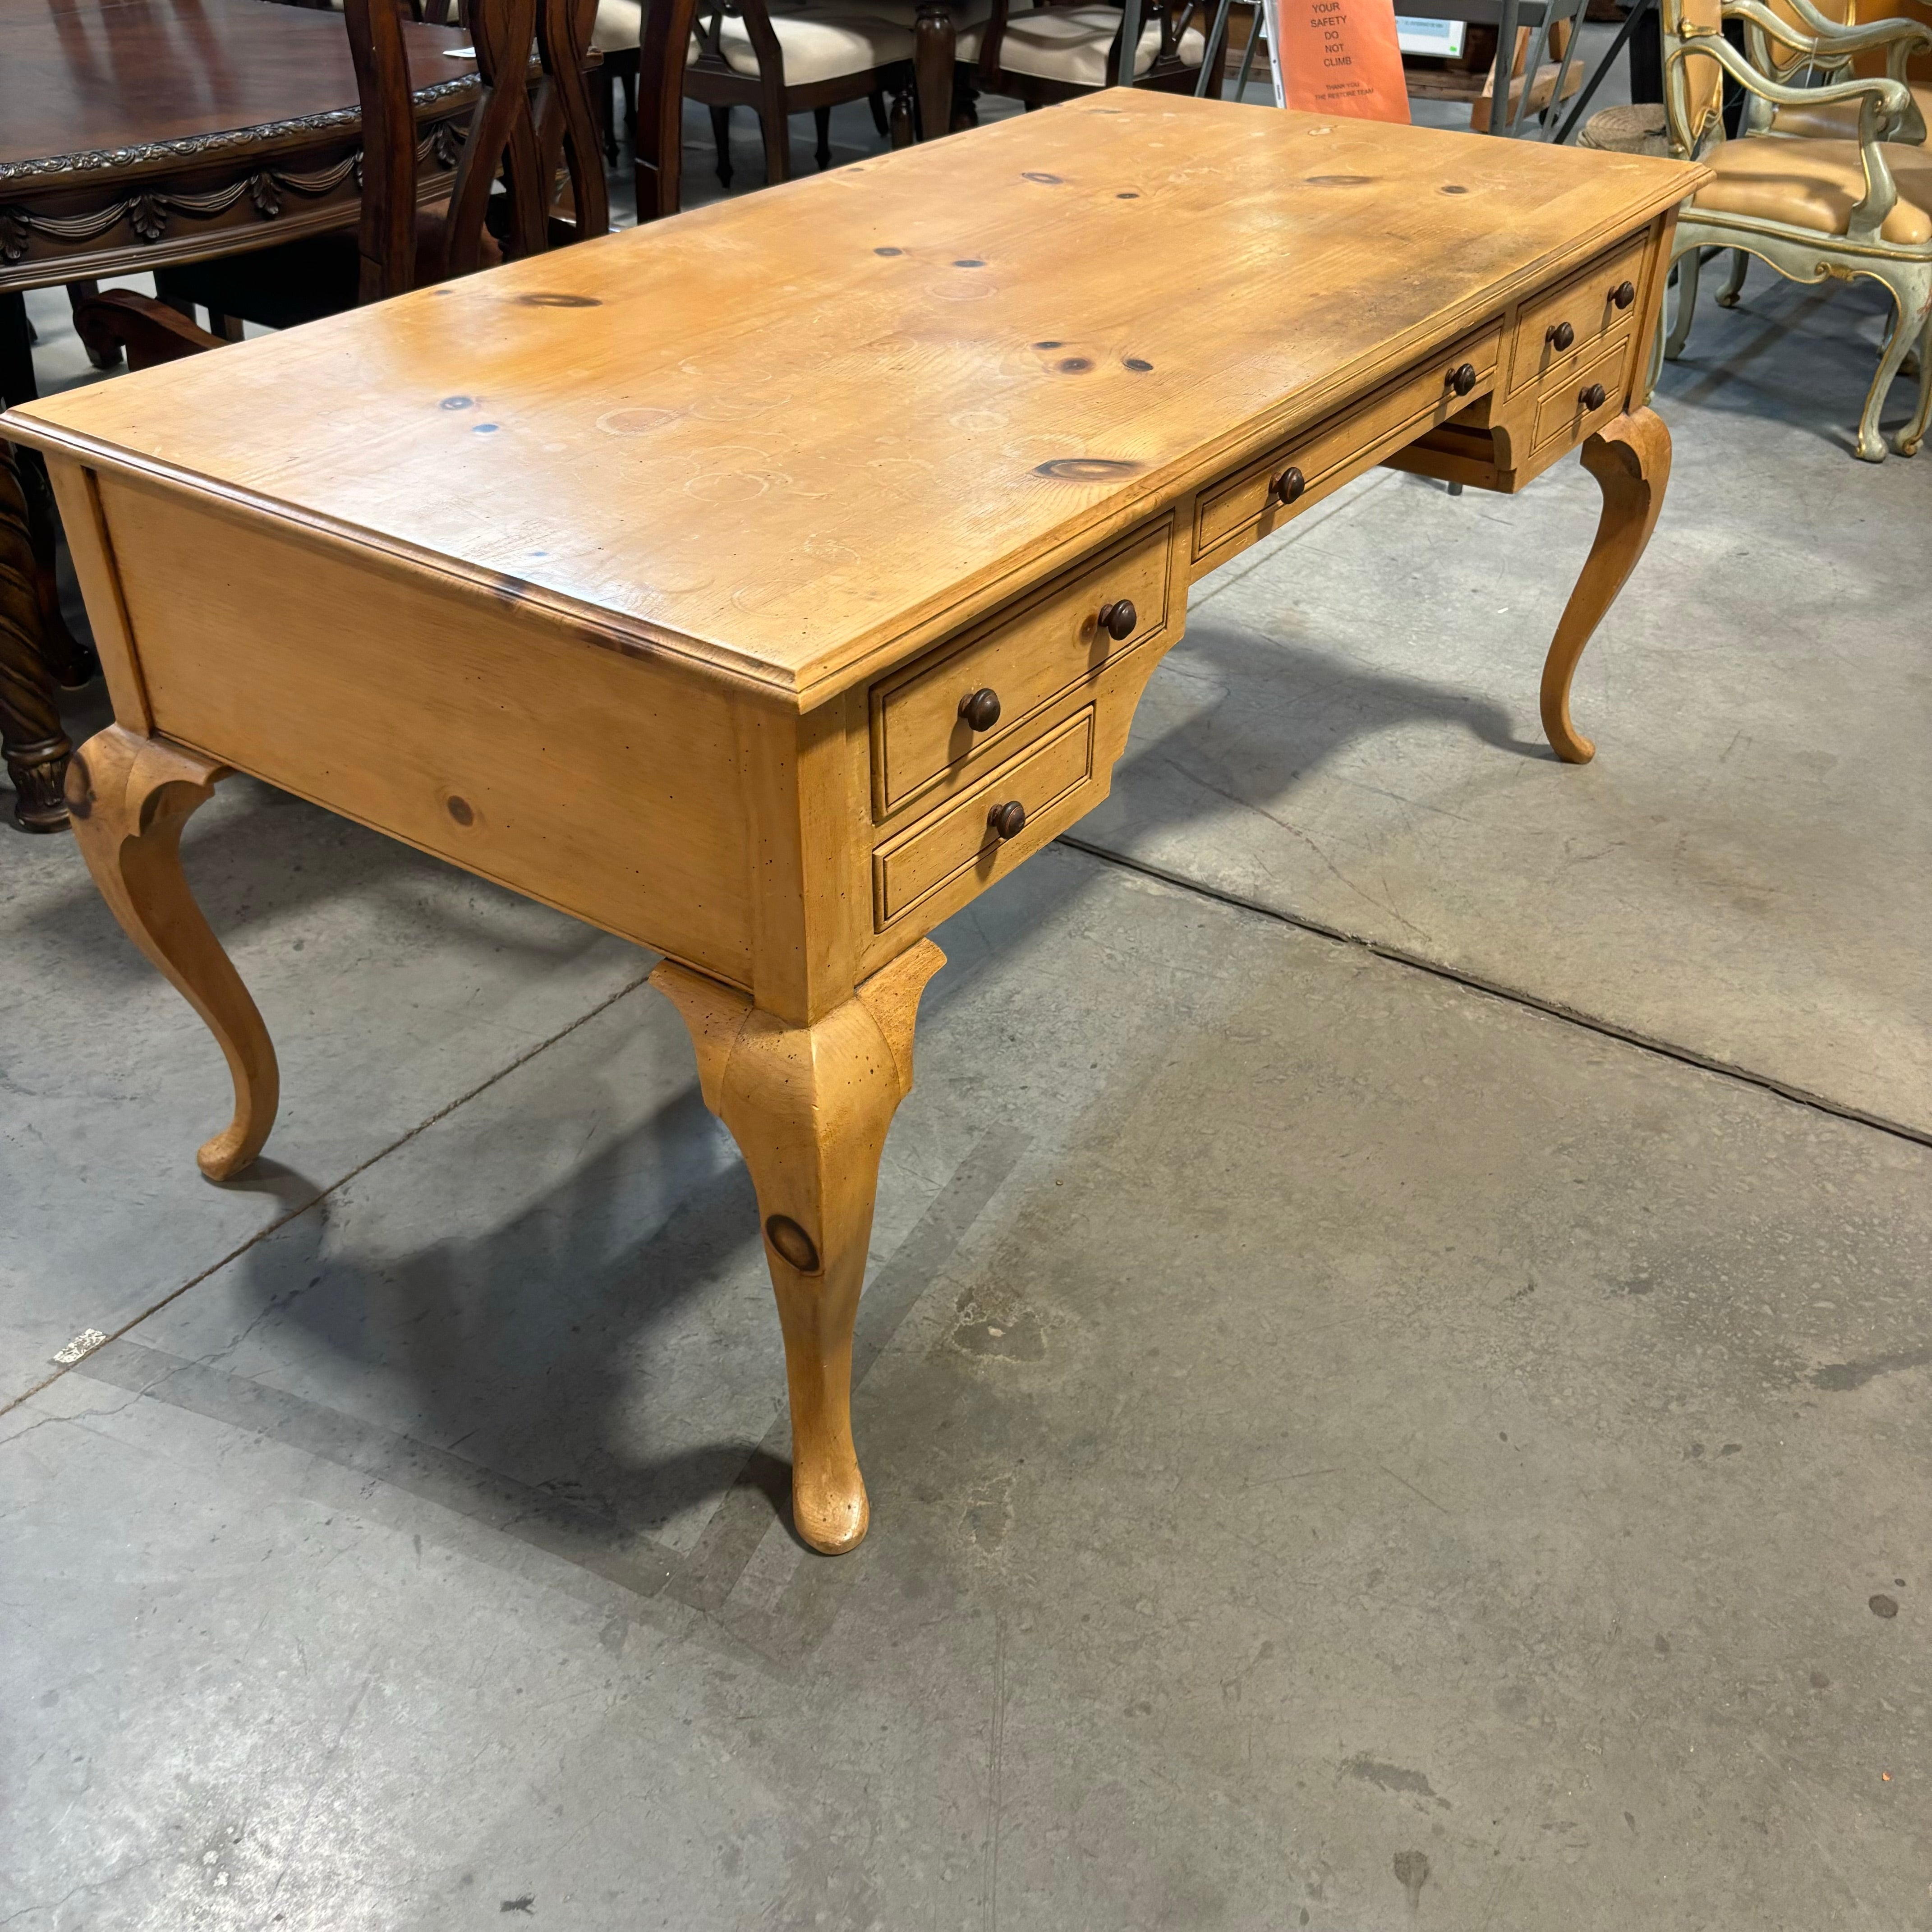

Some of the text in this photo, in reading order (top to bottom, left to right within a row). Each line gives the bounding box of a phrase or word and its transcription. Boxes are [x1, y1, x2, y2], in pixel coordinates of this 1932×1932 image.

[1312, 2, 1340, 13] YOUR
[1311, 15, 1347, 28] SAFETY
[1325, 31, 1339, 40] DO
[1325, 44, 1343, 53] NOT
[1324, 57, 1352, 67] CLIMB
